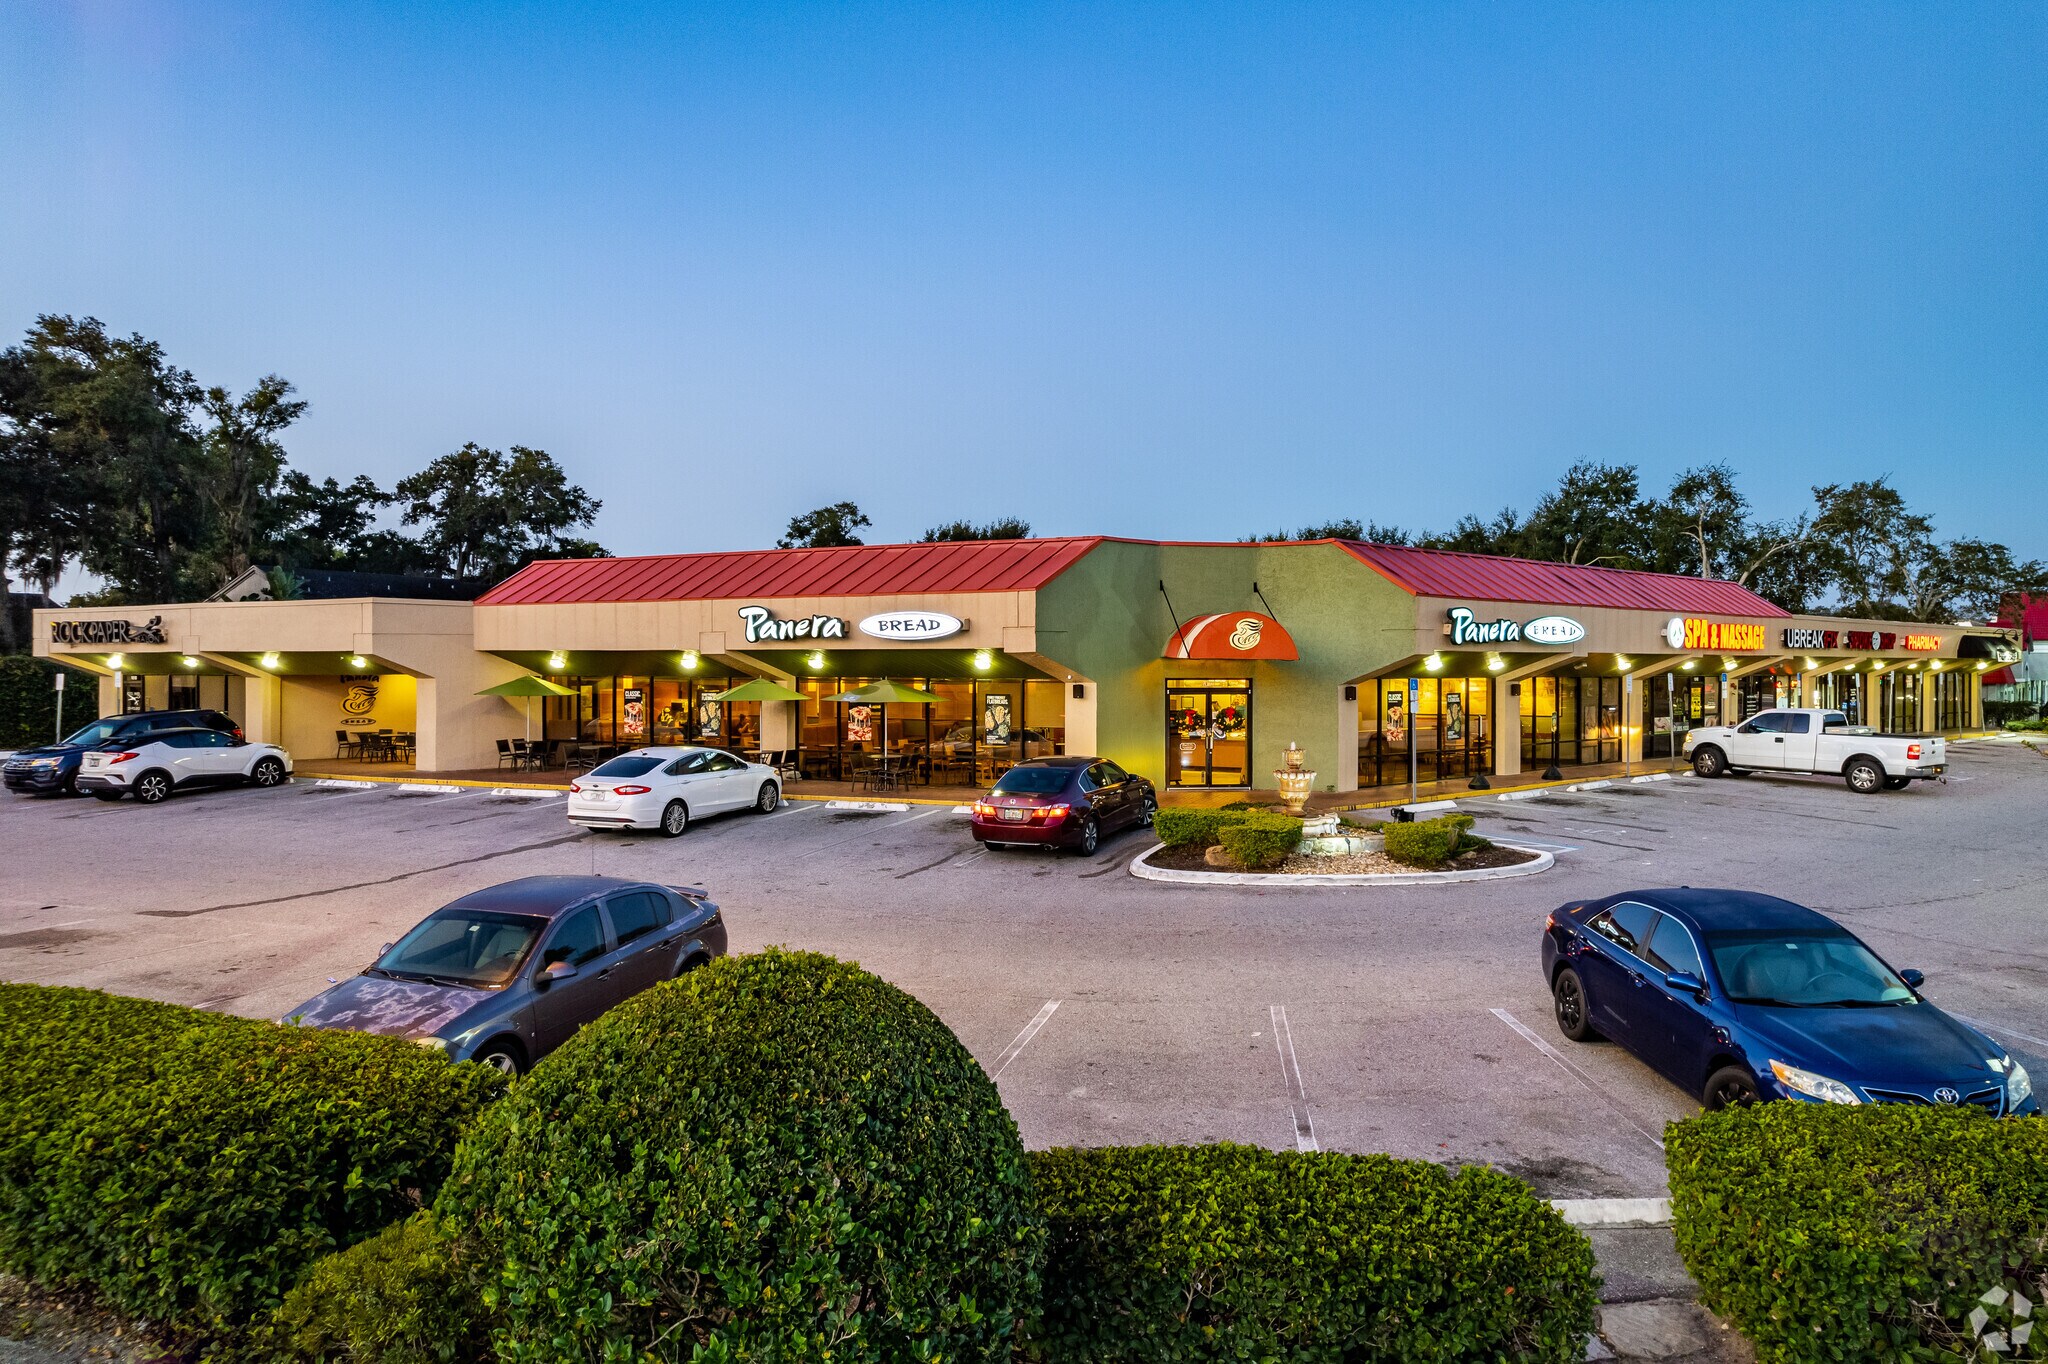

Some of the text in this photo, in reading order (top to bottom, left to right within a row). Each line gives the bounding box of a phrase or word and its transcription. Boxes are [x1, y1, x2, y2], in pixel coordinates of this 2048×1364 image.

[738, 606, 845, 642] Panera
[878, 619, 941, 632] BREAD
[1449, 607, 1519, 645] Panera
[1533, 625, 1576, 636] BREAD
[1684, 618, 1765, 649] SPA & MASSAGE
[1907, 635, 1941, 650] PHARMACY
